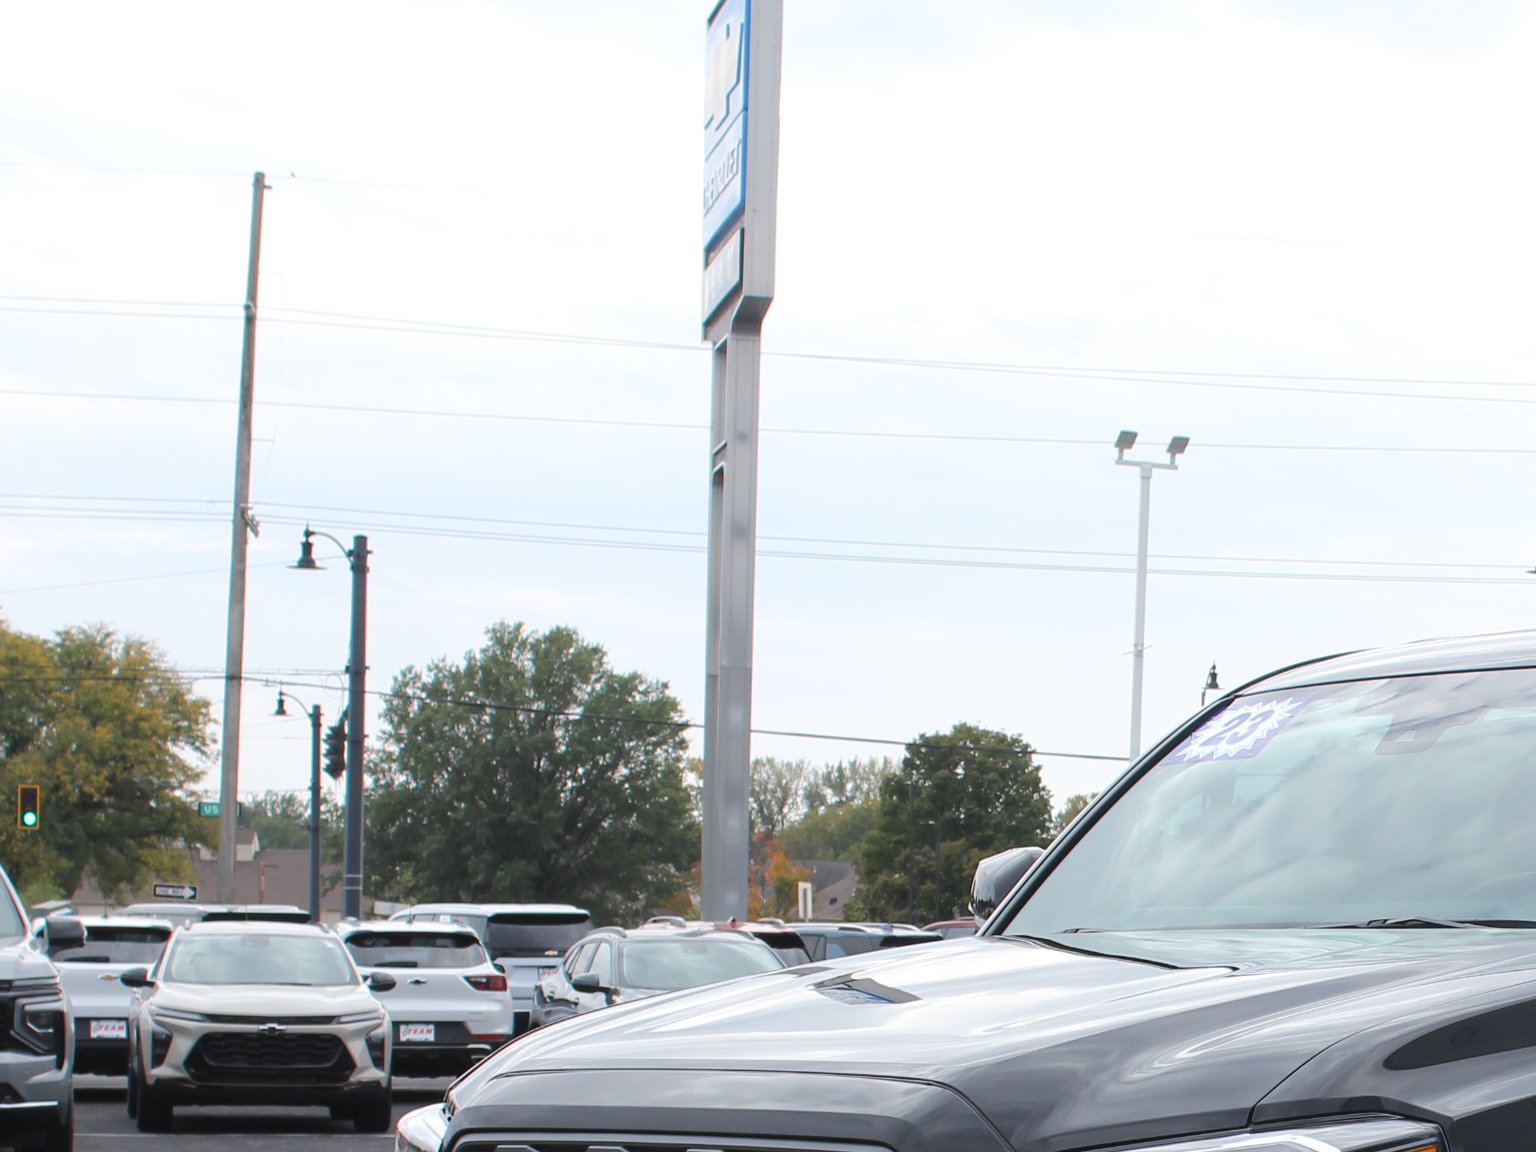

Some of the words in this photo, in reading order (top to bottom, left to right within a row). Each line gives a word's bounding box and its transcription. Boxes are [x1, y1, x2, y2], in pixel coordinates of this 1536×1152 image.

[1198, 709, 1275, 747] 23
[204, 805, 218, 815] US
[98, 1024, 125, 1032] TEAM
